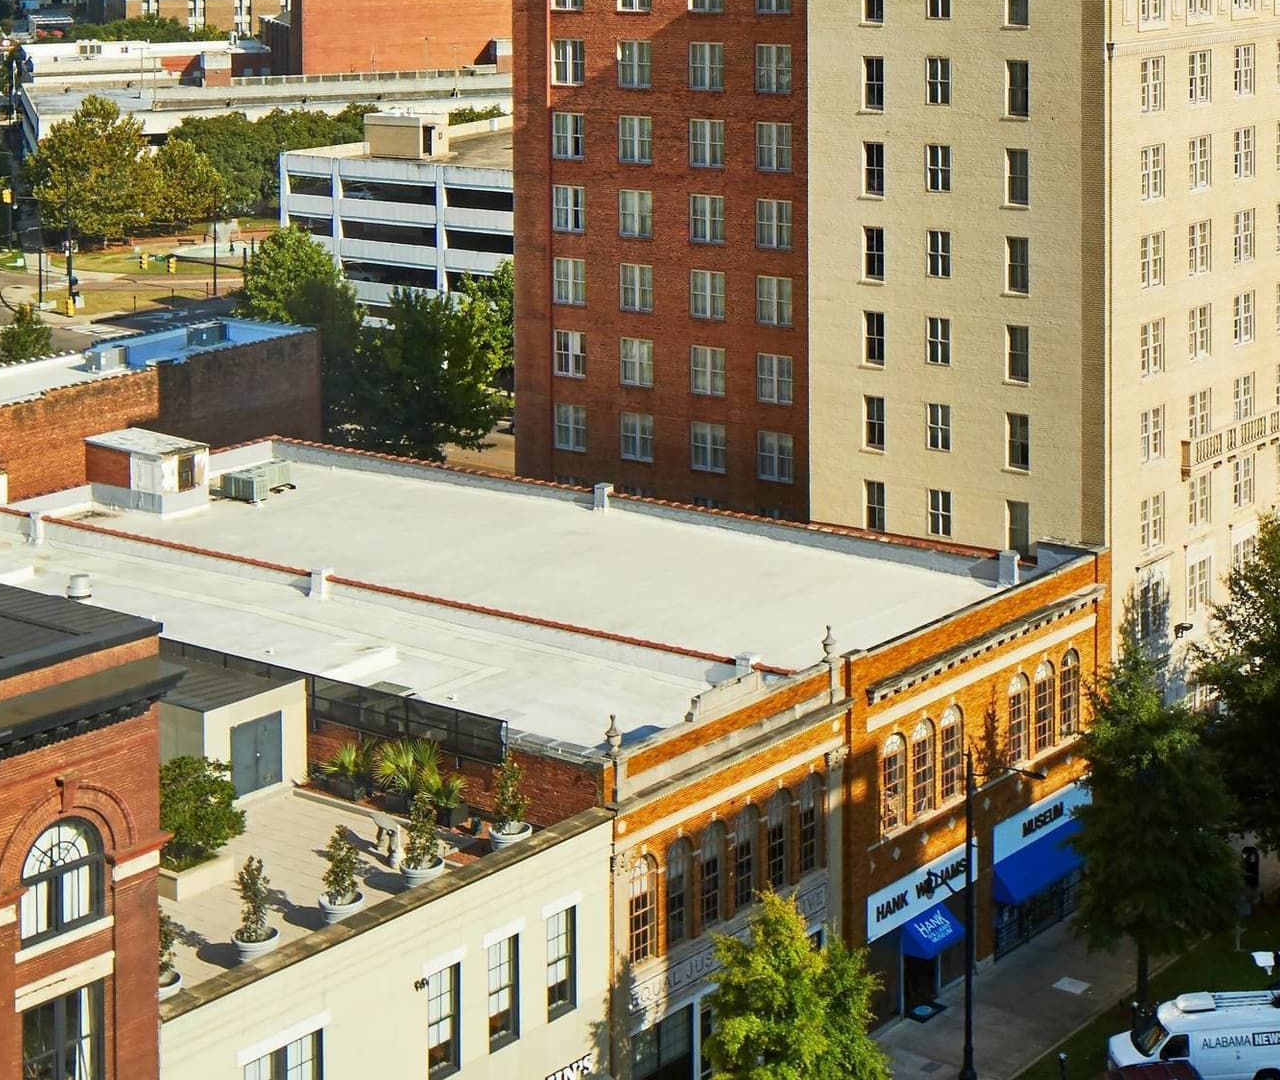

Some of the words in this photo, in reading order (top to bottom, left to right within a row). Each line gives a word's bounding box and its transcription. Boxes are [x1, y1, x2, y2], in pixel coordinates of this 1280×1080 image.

[1023, 802, 1064, 838] MUSEUM
[876, 890, 909, 922] HANK
[914, 909, 950, 938] HANK
[1202, 1035, 1251, 1049] ALABAMA
